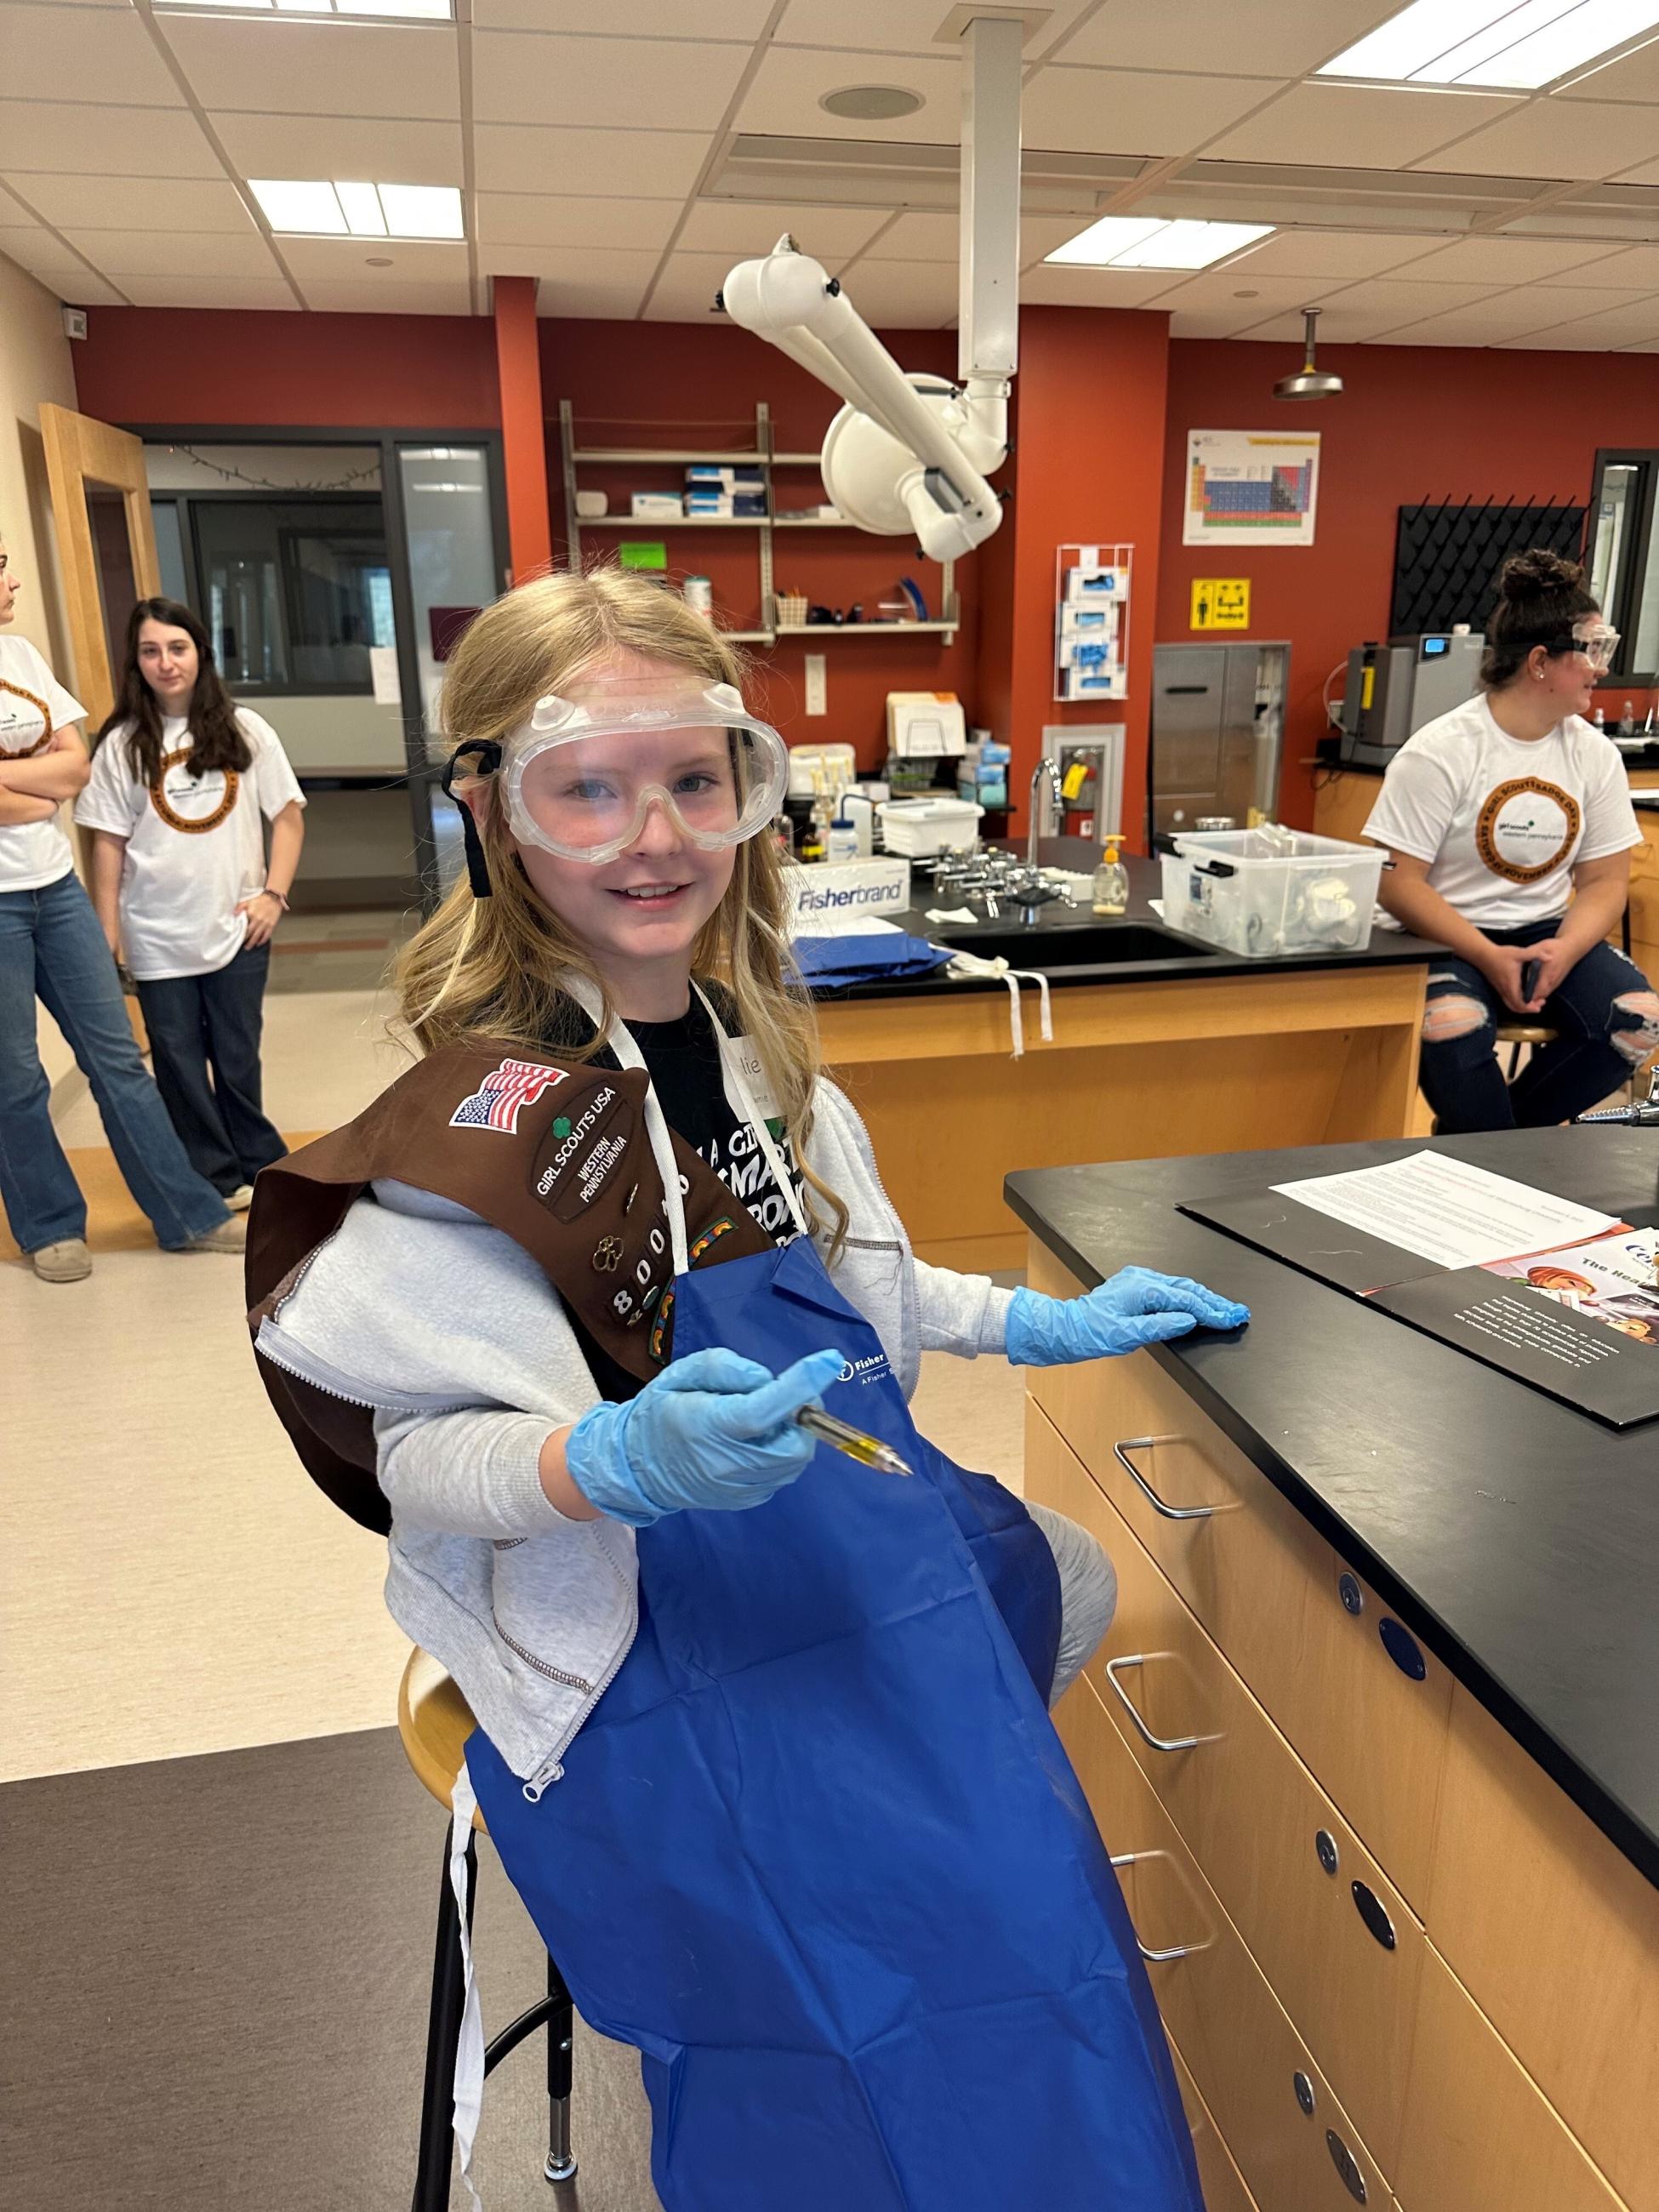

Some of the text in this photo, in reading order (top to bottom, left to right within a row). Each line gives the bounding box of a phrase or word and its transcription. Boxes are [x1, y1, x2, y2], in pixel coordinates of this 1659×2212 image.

[798, 880, 902, 912] Fisherbrand
[537, 1086, 616, 1195] GIRL SCOUTS USA
[578, 1136, 611, 1182] WESTERN
[579, 1136, 627, 1203] PENNSYLVANIA
[1582, 1257, 1608, 1272] The
[854, 1354, 884, 1371] Fisher
[867, 1371, 887, 1383] Fisher
